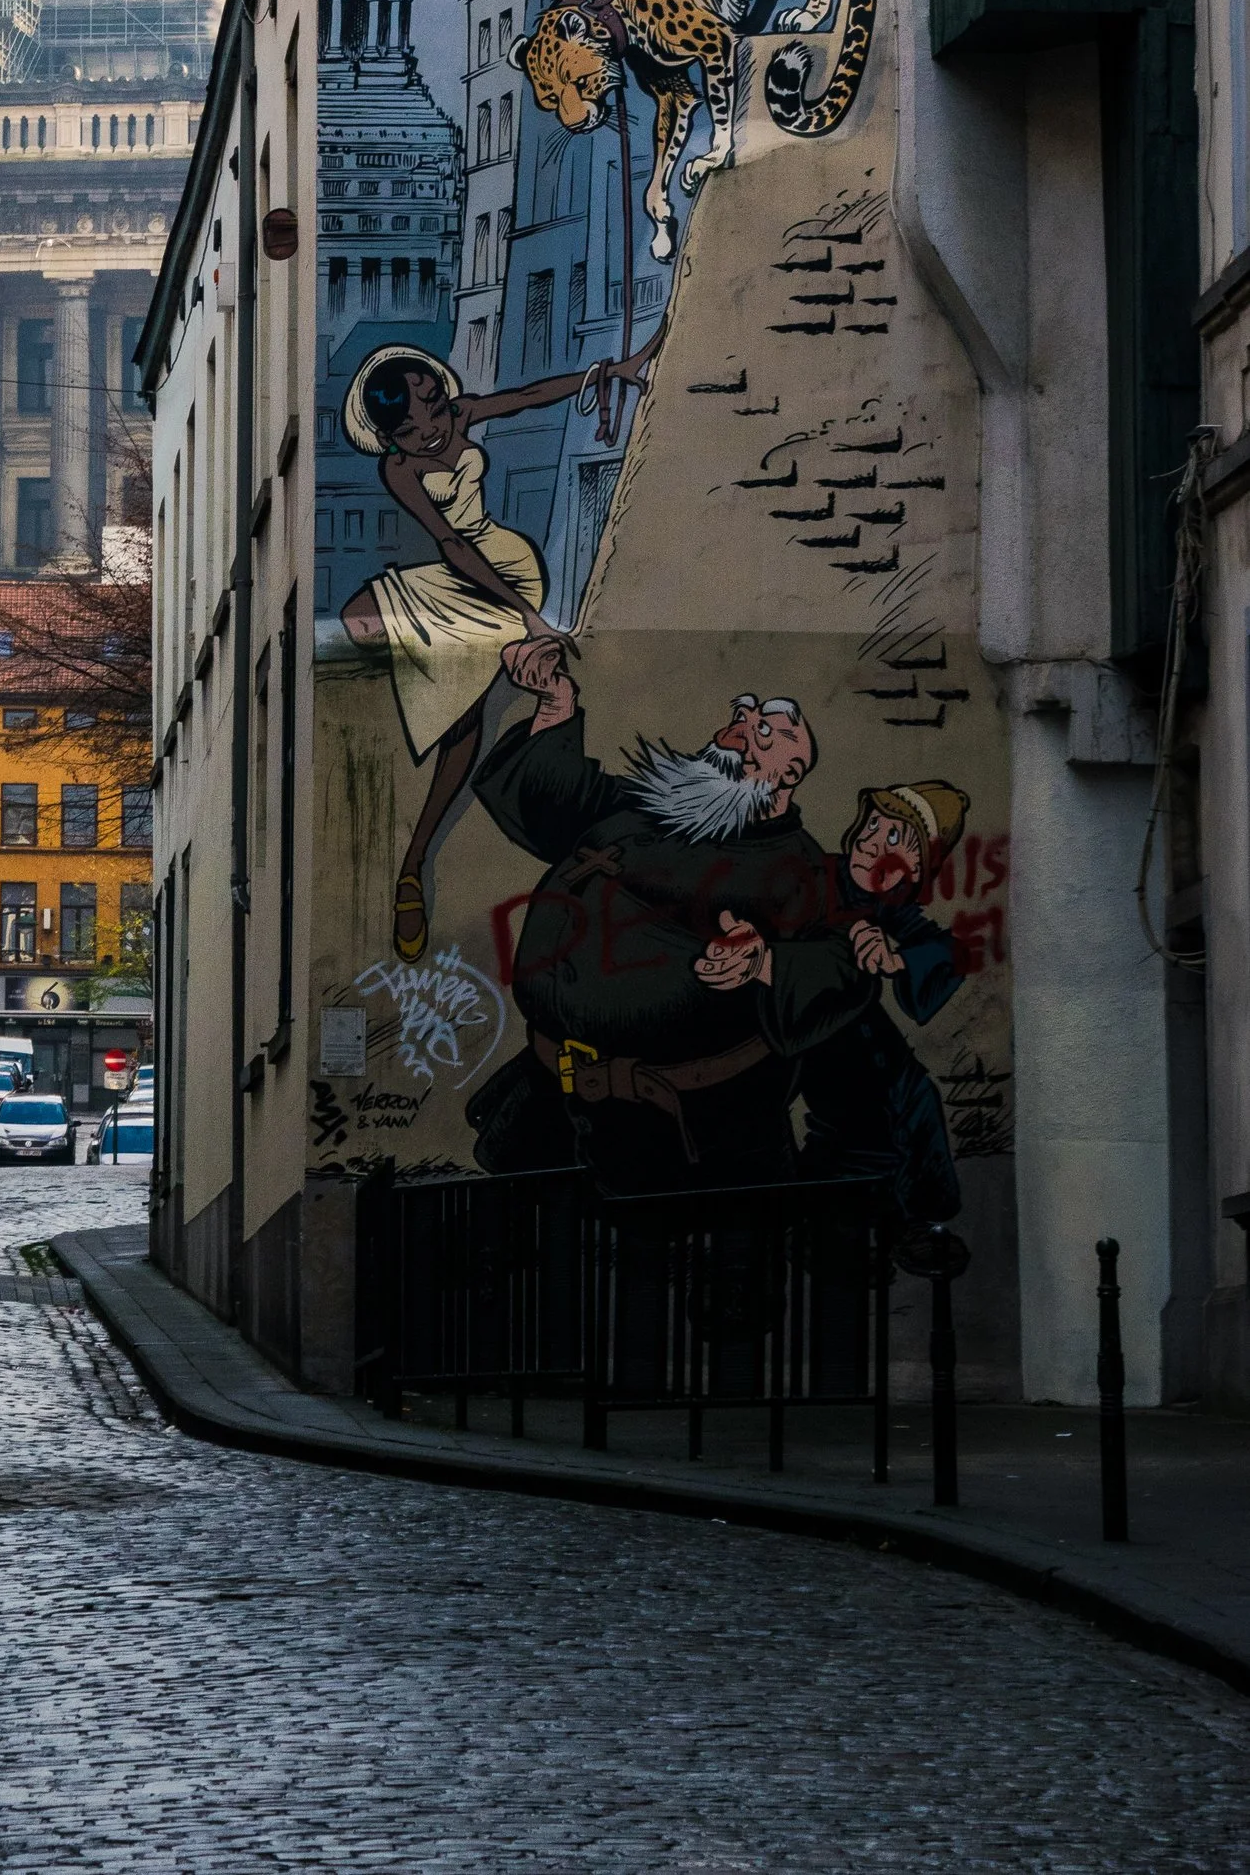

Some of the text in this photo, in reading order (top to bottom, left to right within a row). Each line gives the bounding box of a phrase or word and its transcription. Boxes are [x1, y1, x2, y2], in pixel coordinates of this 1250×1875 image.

[350, 1082, 431, 1112] VERRON
[357, 1113, 417, 1129] & YANN
